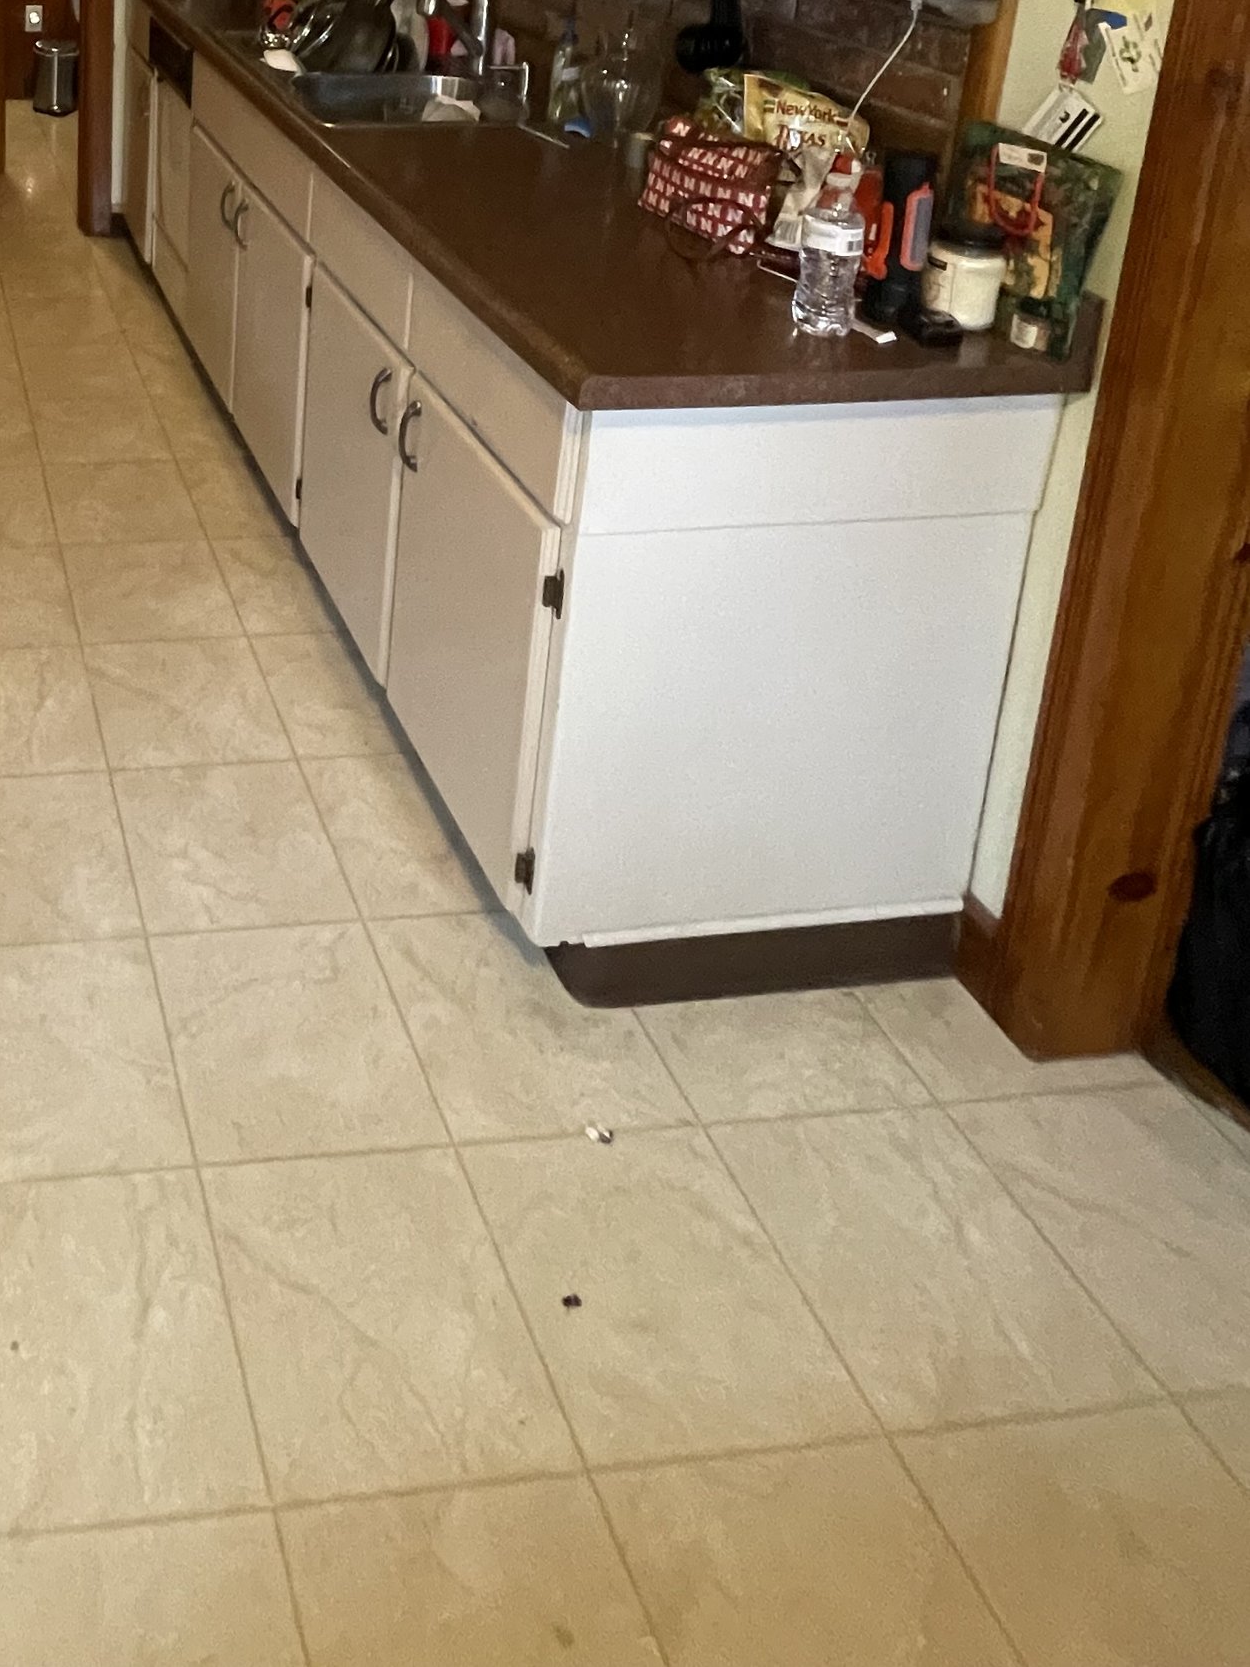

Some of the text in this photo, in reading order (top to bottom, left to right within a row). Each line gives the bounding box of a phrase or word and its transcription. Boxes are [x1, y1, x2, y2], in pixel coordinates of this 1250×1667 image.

[776, 100, 837, 124] New York
[672, 122, 690, 137] N
[737, 192, 755, 207] N
